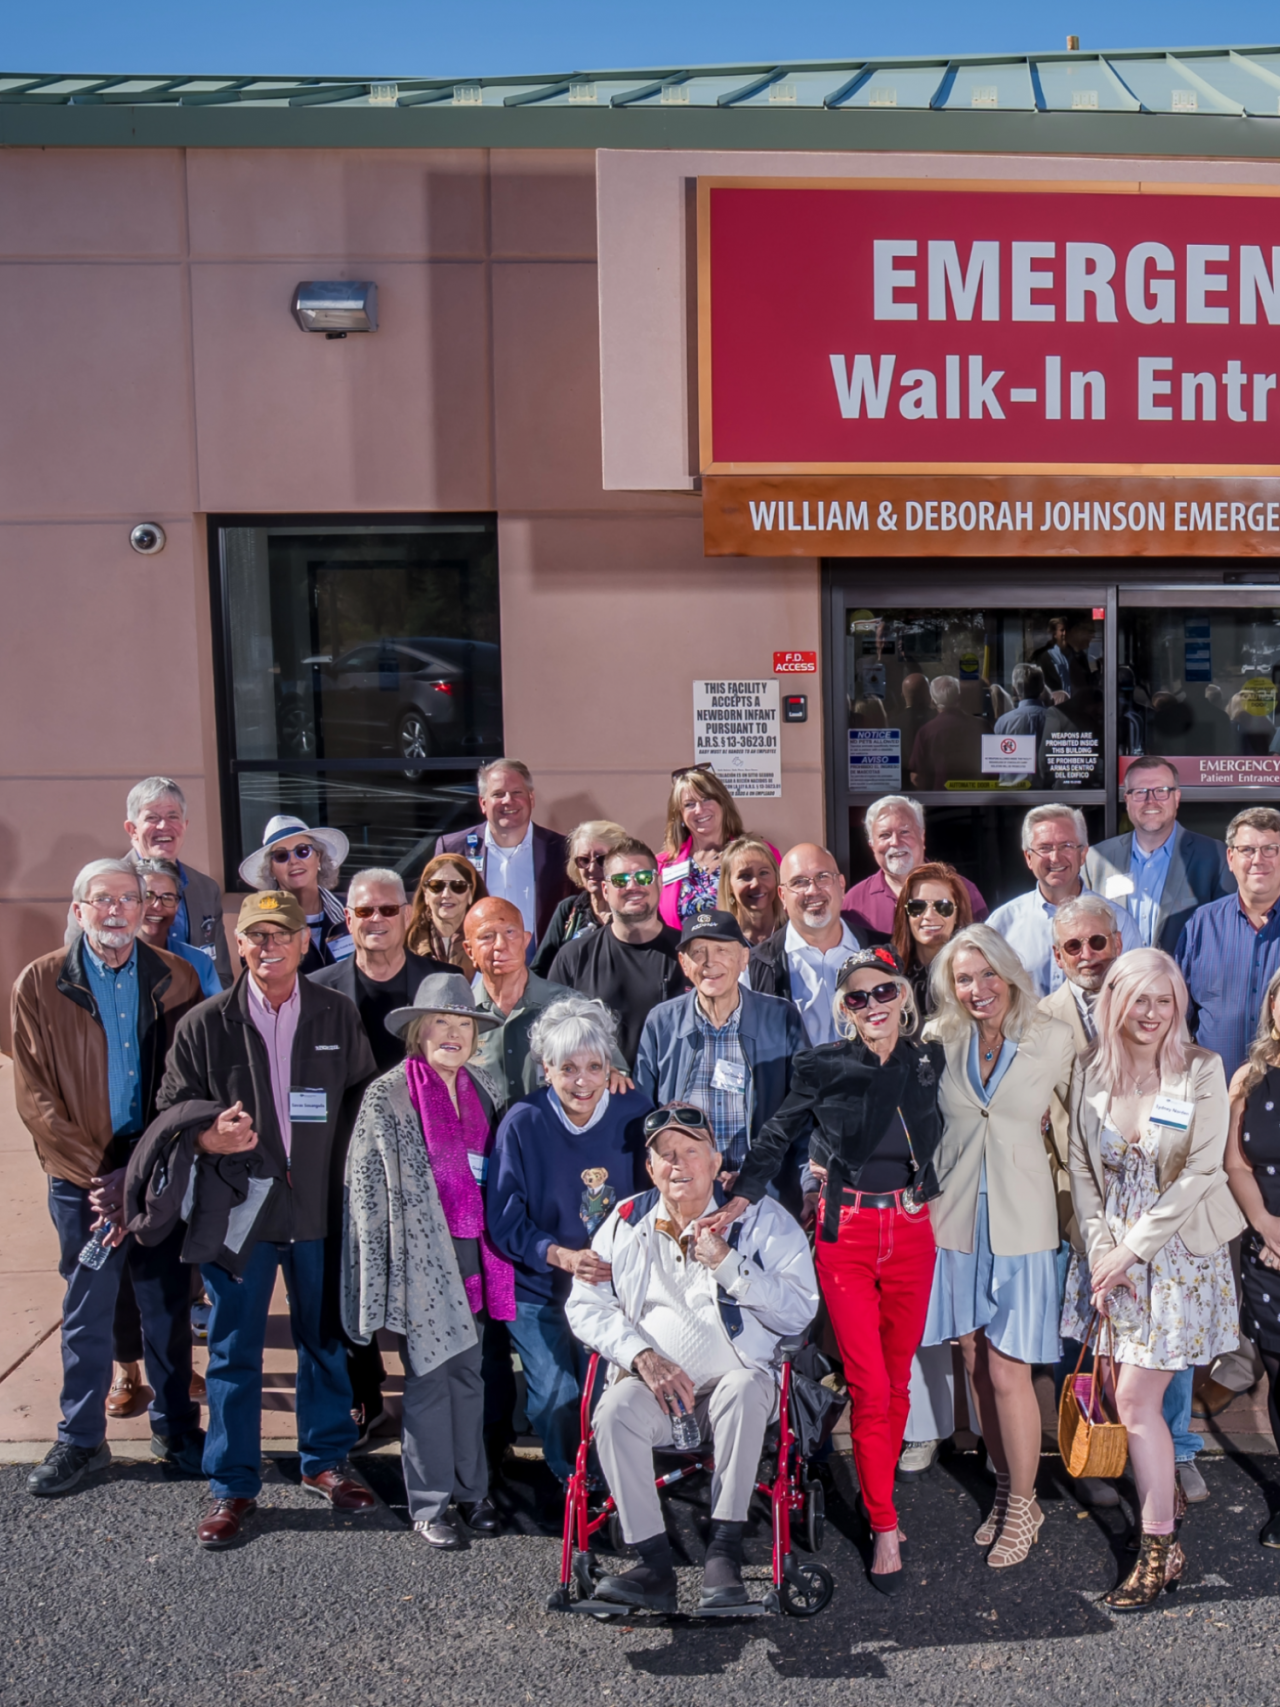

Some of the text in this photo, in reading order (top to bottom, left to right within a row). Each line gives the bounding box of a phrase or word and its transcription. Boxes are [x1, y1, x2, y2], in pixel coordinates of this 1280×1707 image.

[830, 353, 1107, 420] Walk-In
[749, 501, 869, 531] WILLIAM
[877, 501, 897, 531] &
[906, 501, 1033, 531] DEBORAH
[1041, 501, 1165, 531] JOHNSON
[785, 653, 804, 662] F.D.
[775, 663, 815, 672] ACCESS
[704, 682, 767, 694] THIS FACILITY
[711, 696, 761, 707] ACCEPTS A
[697, 709, 776, 721] NEWBORN INFANT
[705, 722, 768, 734] PURSUANT TO
[857, 731, 892, 739] NOTICE
[697, 736, 720, 748] A.R.S.
[727, 736, 777, 748] 13-3623.01
[1080, 739, 1099, 747] INSIDE
[861, 756, 890, 764] AVISO
[1055, 771, 1066, 779] DEL
[1200, 773, 1280, 783] Patient Entrance
